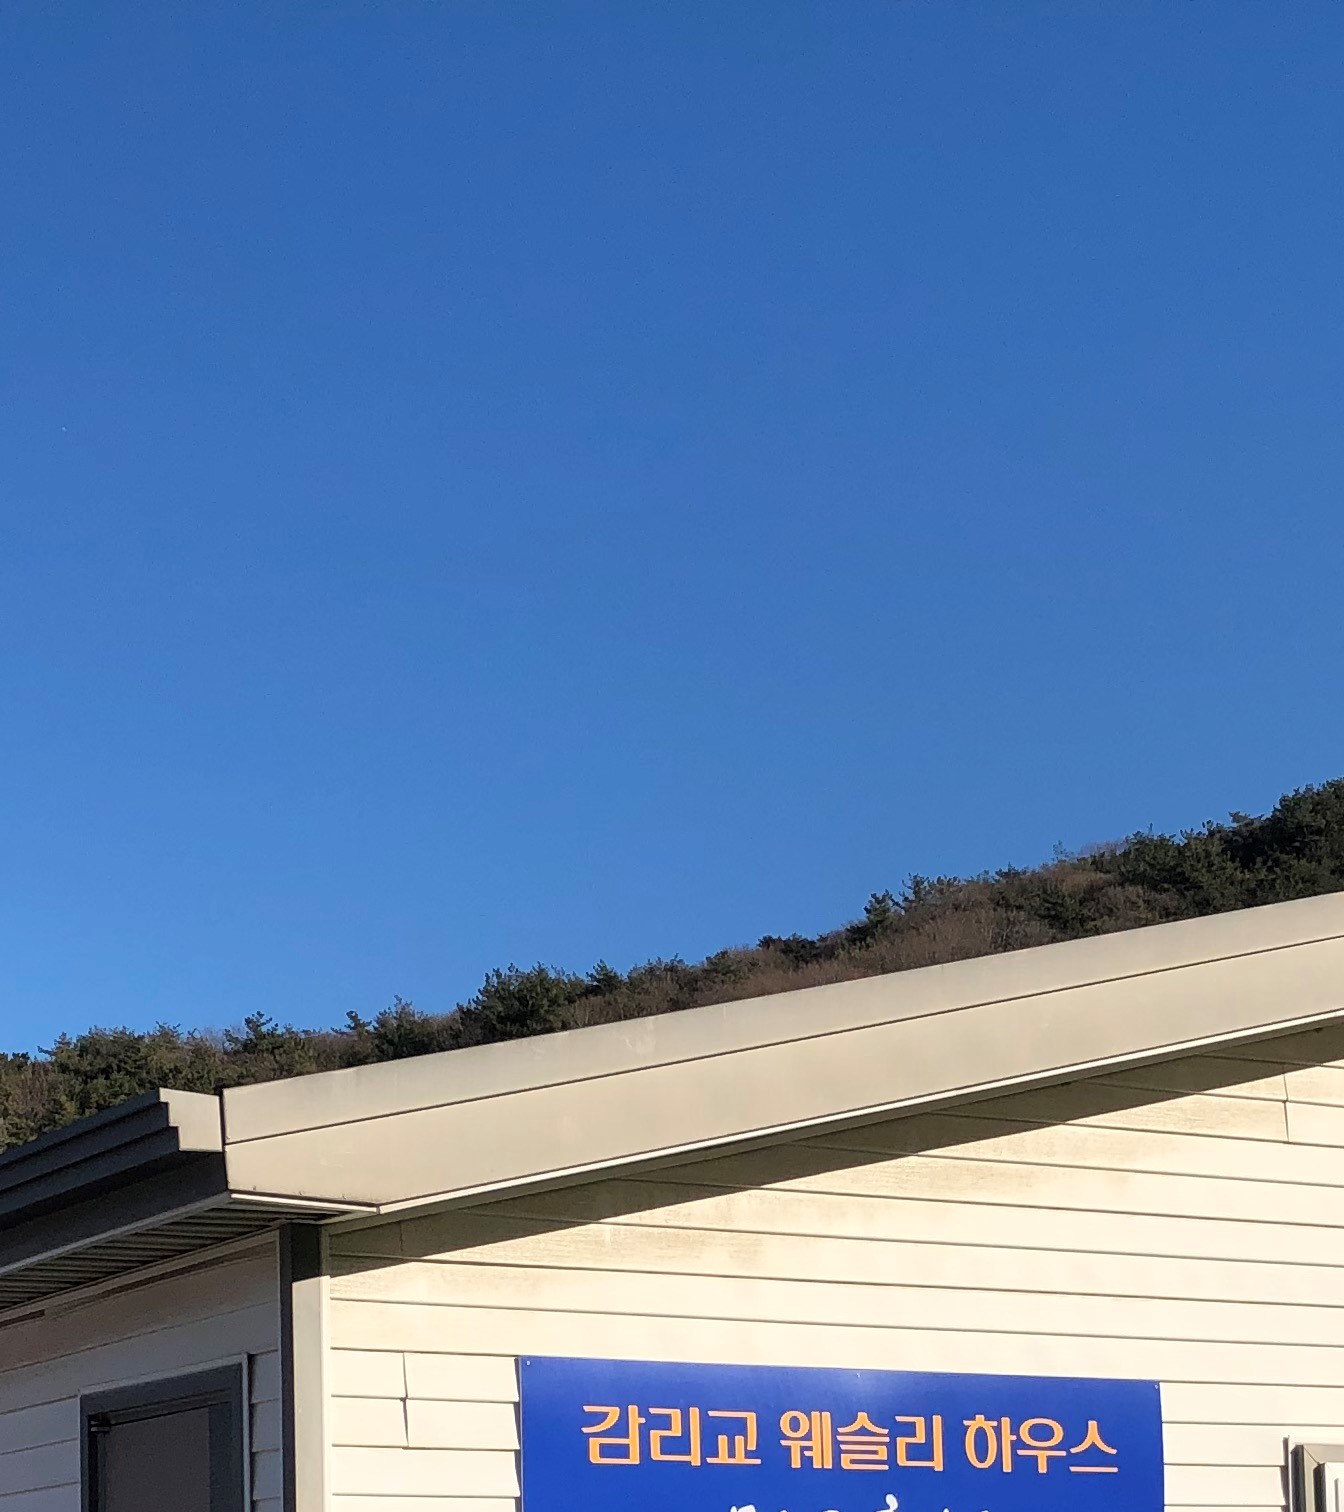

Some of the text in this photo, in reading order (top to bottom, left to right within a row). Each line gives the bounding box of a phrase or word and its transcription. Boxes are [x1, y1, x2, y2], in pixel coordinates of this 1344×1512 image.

[581, 1405, 1118, 1473] 감리교 웨슬리 하우스
